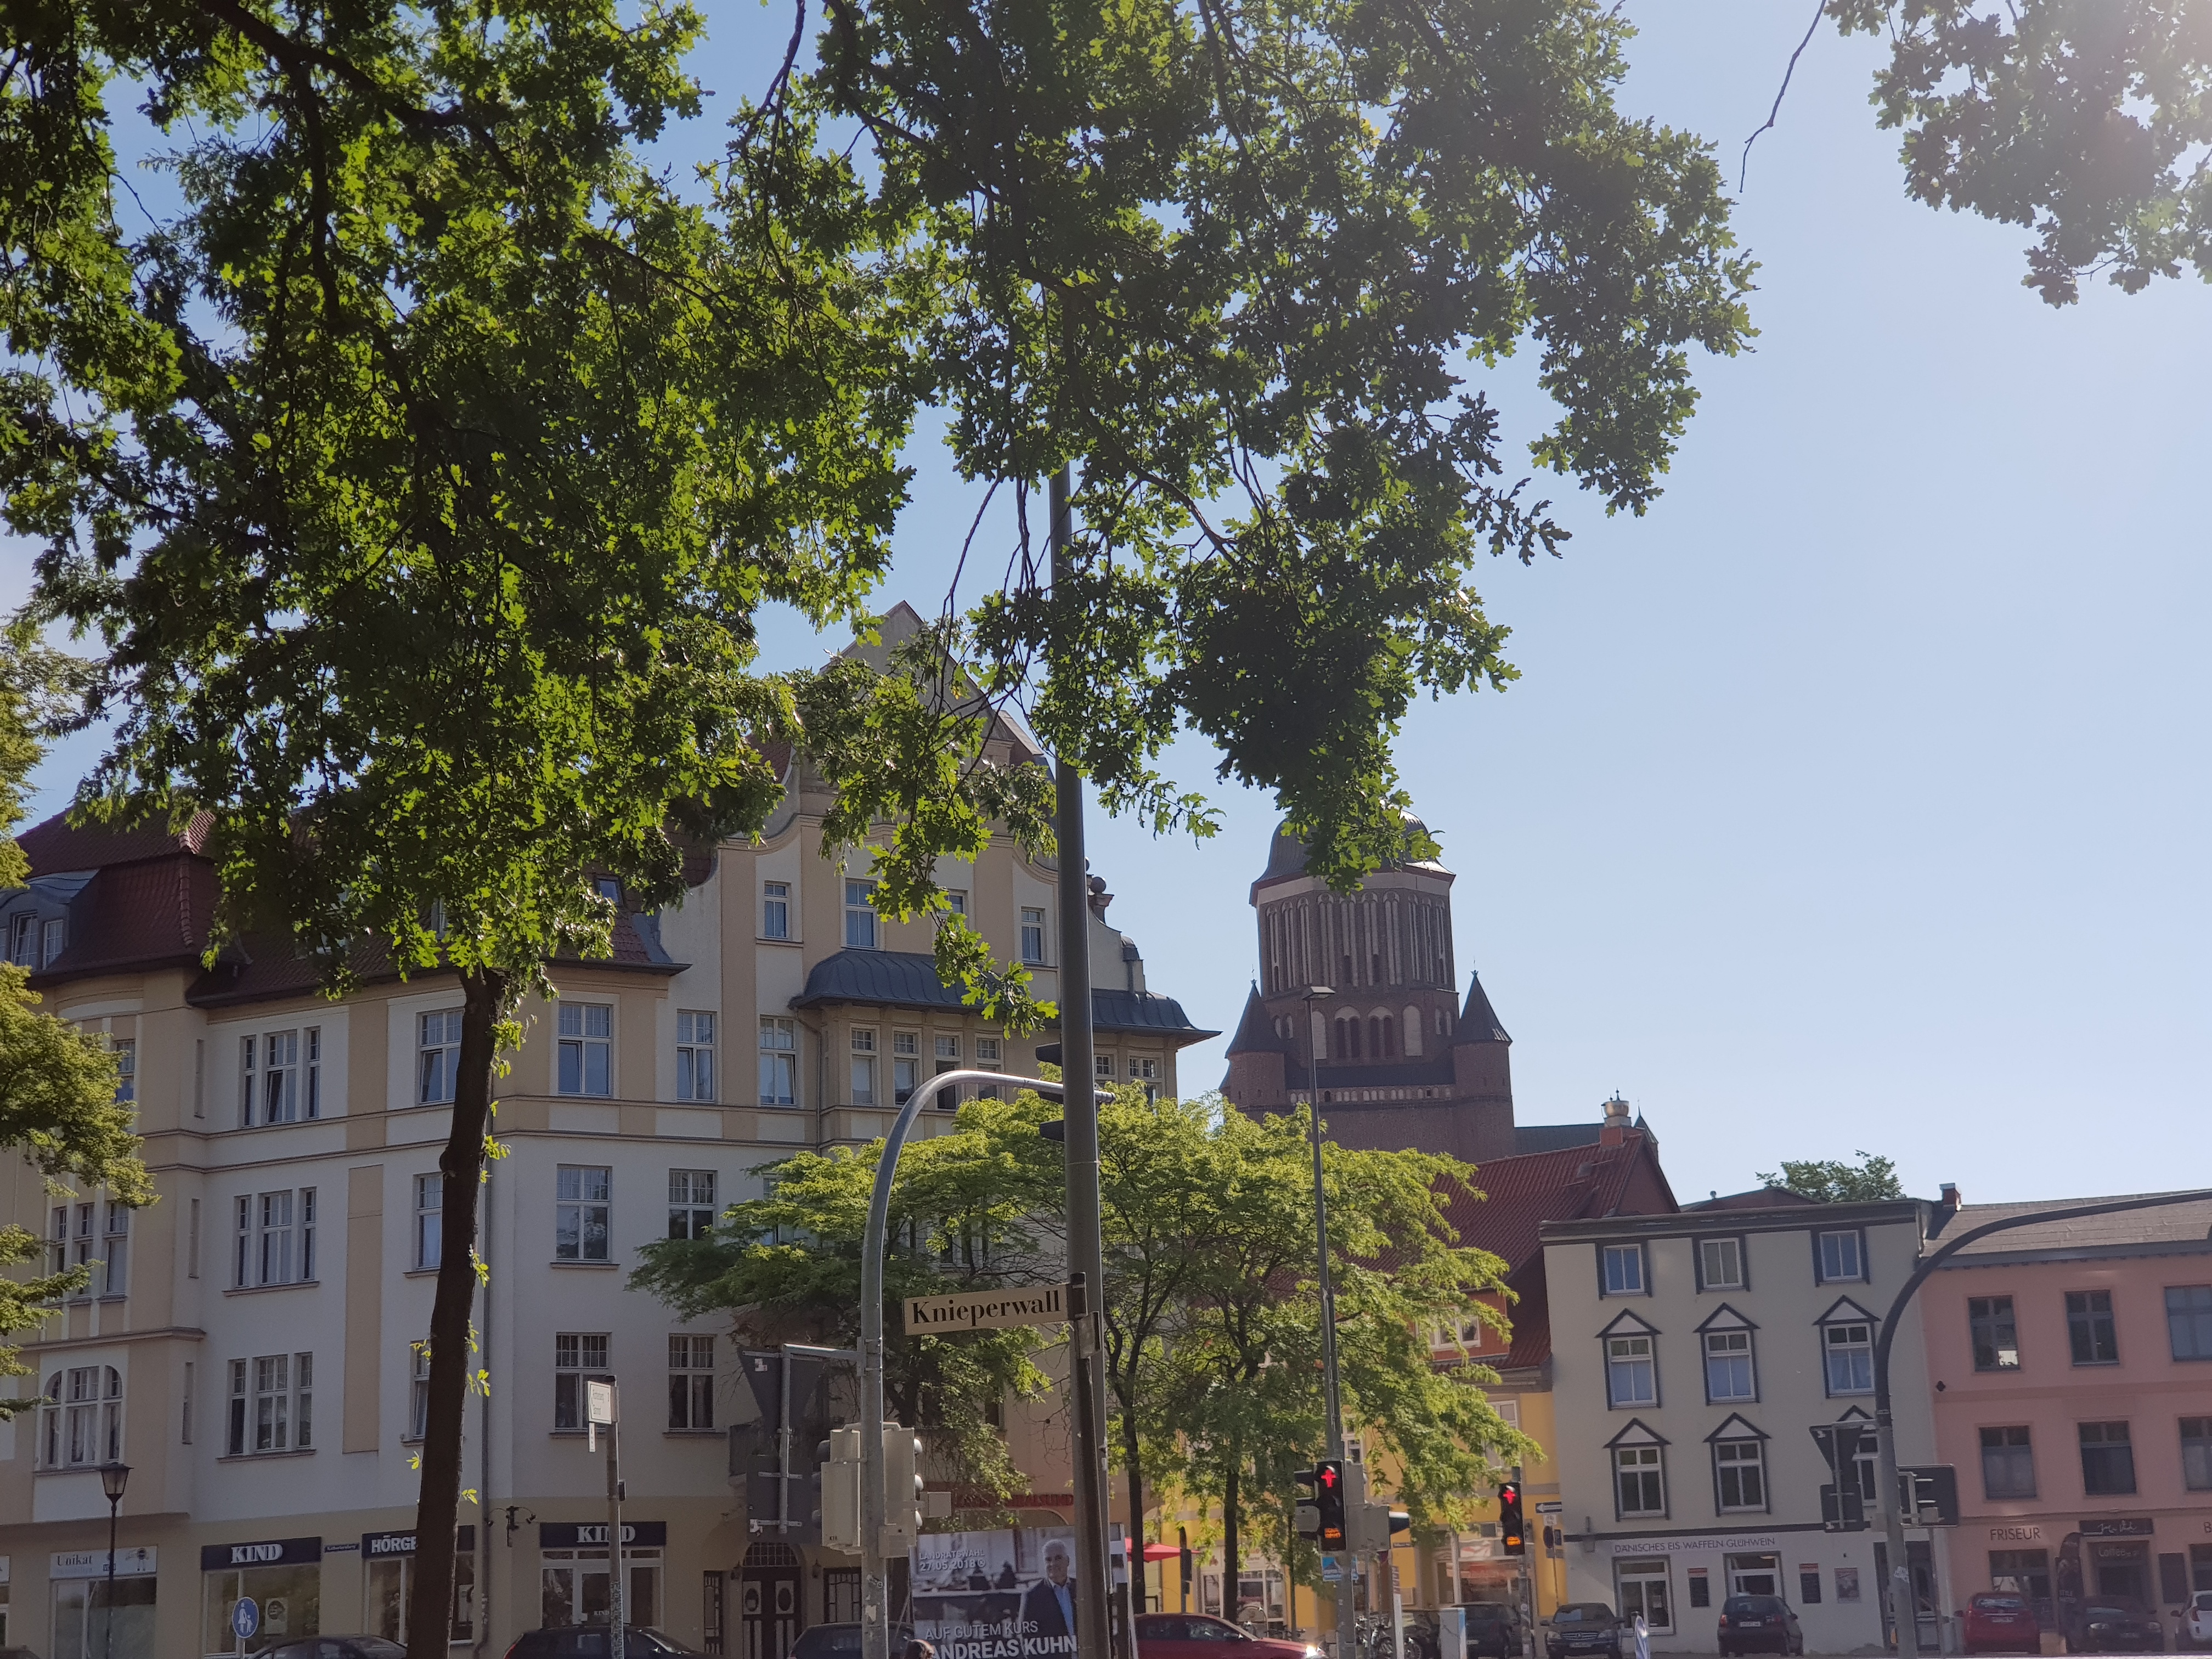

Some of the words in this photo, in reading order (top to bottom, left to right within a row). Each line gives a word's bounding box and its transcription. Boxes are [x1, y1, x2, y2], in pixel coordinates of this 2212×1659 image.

[912, 1290, 1061, 1327] Knieperwall
[1990, 1527, 2040, 1541] FRISEUR
[1615, 1543, 1665, 1553] DÄNISCHES
[1668, 1542, 1680, 1550] EIS
[1683, 1540, 1723, 1549] WAFFELN
[1726, 1537, 1775, 1548] GLÜHWEIN
[57, 1554, 92, 1566] Unikat
[230, 1544, 283, 1564] KIND
[919, 1549, 985, 1561] LANDRATSWAHL
[920, 1559, 975, 1572] 27.05.2018
[925, 1627, 951, 1640] AUF
[954, 1623, 1002, 1639] GUTEM
[1004, 1620, 1039, 1634] KURS
[1023, 1635, 1077, 1656] KUHN
